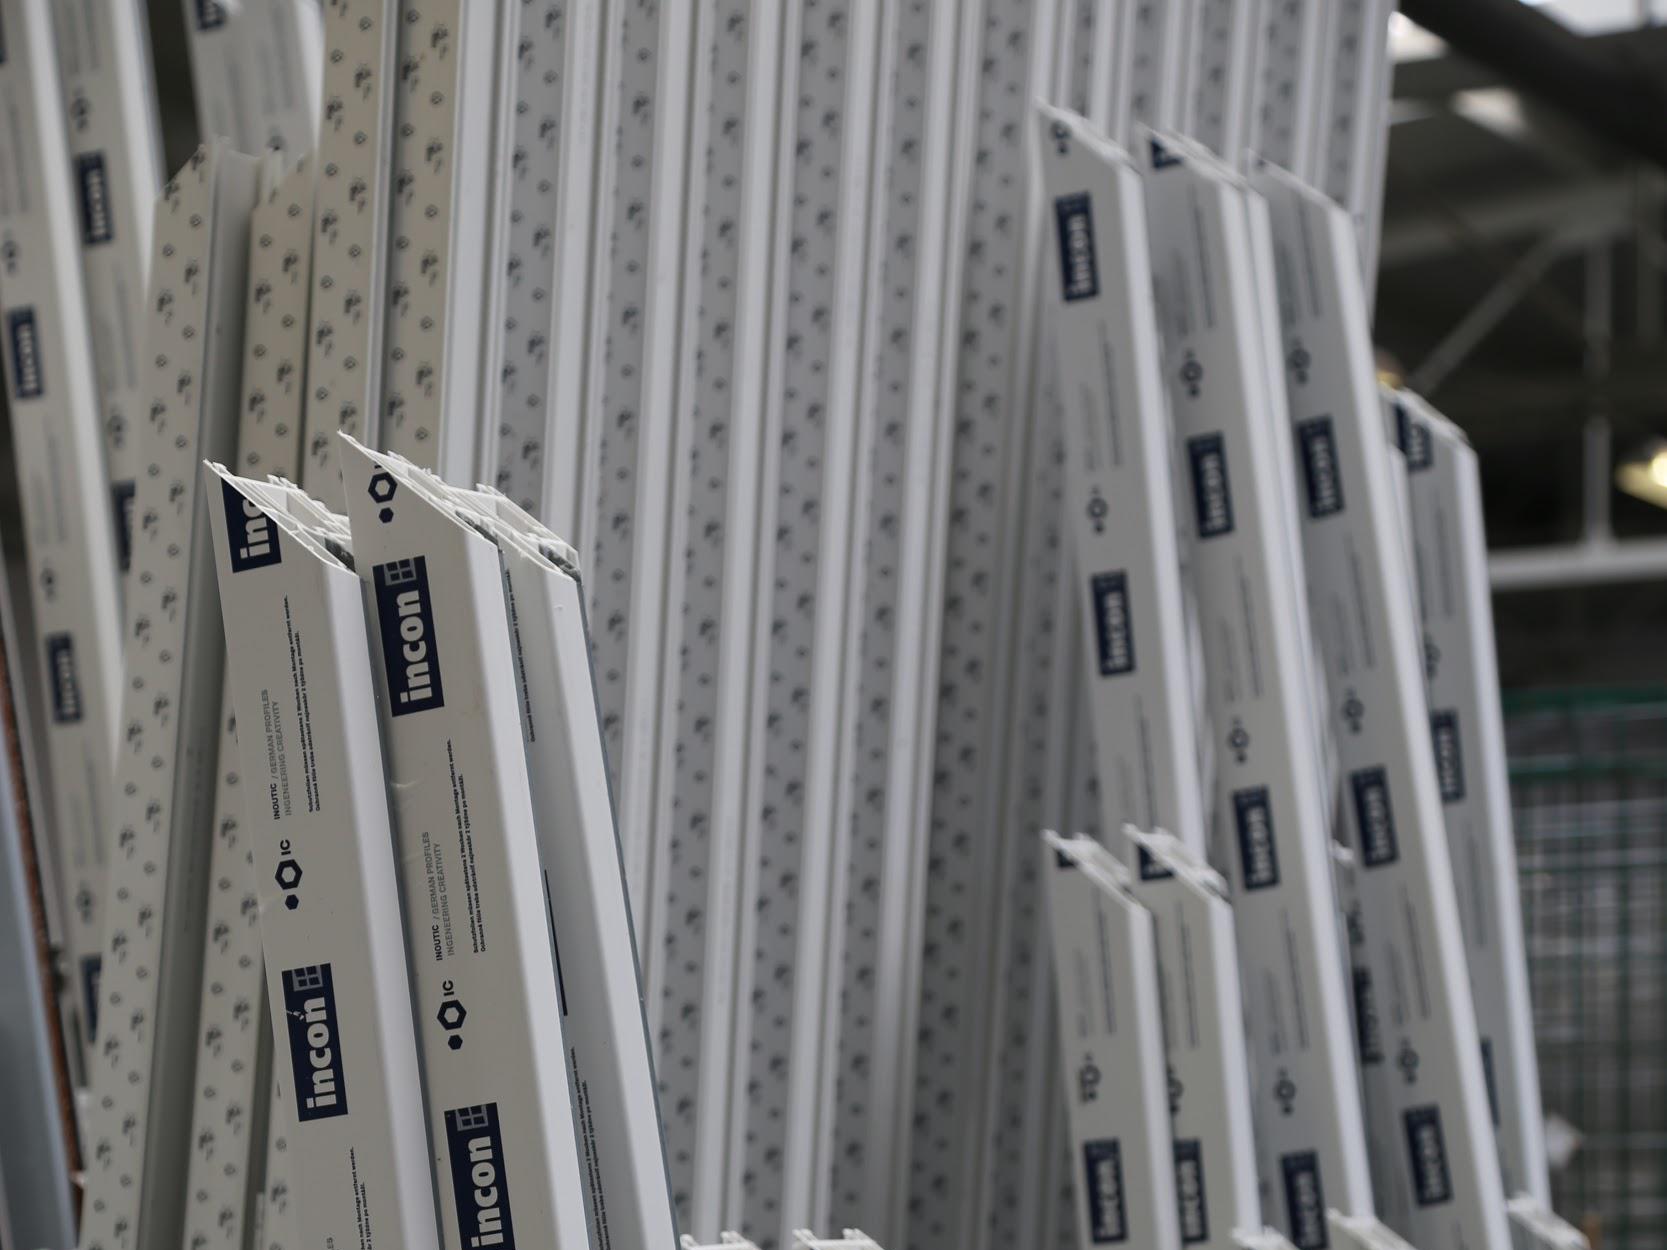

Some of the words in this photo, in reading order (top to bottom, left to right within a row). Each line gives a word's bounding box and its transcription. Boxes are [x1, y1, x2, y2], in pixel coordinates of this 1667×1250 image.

[240, 497, 271, 560] inc
[400, 590, 432, 704] incon
[261, 689, 272, 733] PROFILES
[272, 701, 284, 752] CREATIVITY
[267, 734, 277, 774] GERMAN
[270, 783, 280, 820] INOUTIC
[278, 754, 292, 816] INGENEERING
[280, 839, 291, 856] IC
[422, 832, 434, 874] PROFILES
[433, 843, 446, 893] CREATIVITY
[428, 876, 439, 914] GERMAN
[432, 924, 443, 961] INOUTIC
[440, 895, 455, 956] INGENEERING
[442, 980, 454, 996] IC
[304, 997, 337, 1109] incon
[468, 1136, 502, 1248] incon
